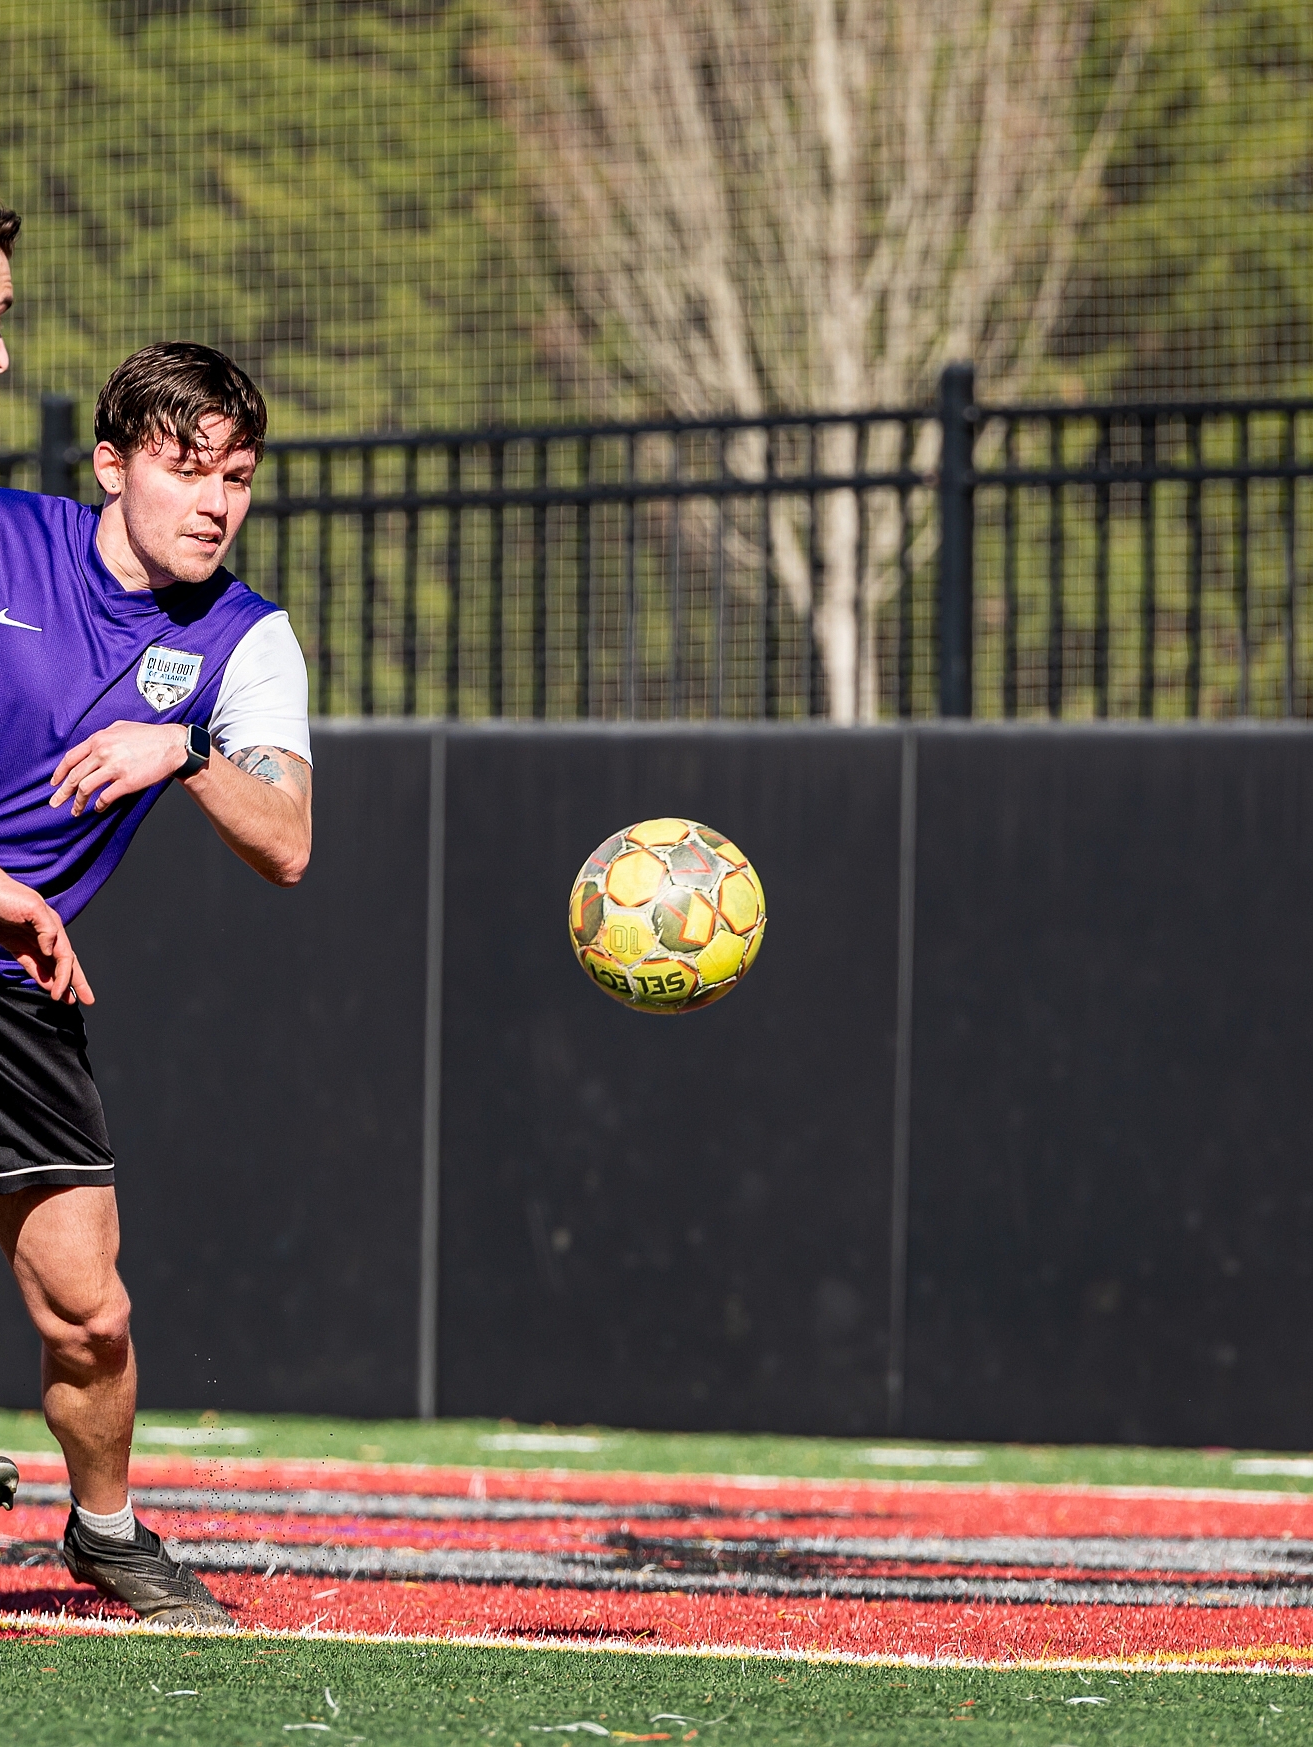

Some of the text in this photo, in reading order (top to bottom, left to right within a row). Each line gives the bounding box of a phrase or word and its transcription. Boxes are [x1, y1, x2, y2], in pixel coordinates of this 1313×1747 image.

[147, 658, 195, 676] CLUB FOOT
[160, 673, 187, 683] ATLANTA
[609, 925, 642, 955] 10
